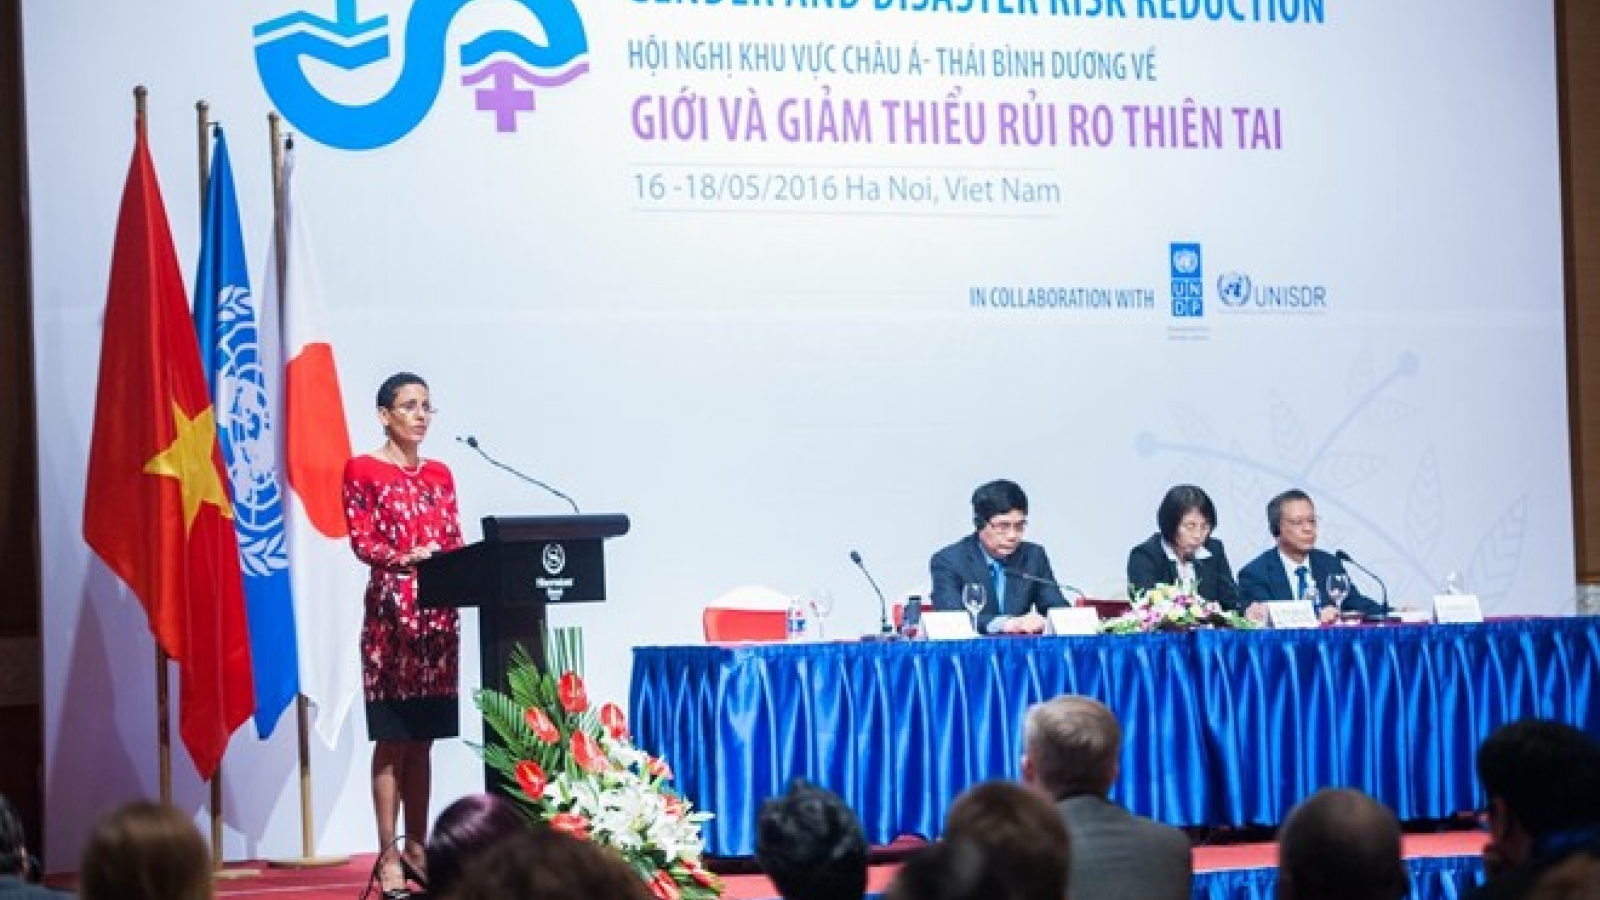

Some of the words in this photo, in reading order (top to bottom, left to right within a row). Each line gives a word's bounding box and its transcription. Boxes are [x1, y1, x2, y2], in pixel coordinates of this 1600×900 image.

[628, 34, 668, 76] HỘI
[675, 40, 732, 78] NGHỊ
[739, 42, 786, 72] KHU
[790, 40, 836, 81] VỰC
[842, 40, 900, 75] CHÂU
[936, 42, 985, 77] THÁI
[993, 44, 1045, 78] BÌNH
[631, 85, 709, 142] GIỚI
[719, 86, 767, 142] VÀ
[777, 85, 872, 144] GIẢM
[881, 85, 987, 145] THIỂU
[999, 89, 1057, 147] RỦI
[1069, 104, 1114, 147] RO
[1122, 97, 1222, 149] THIÊN
[1231, 107, 1282, 149] TAI
[634, 173, 665, 201] 16
[846, 176, 880, 202] Ha
[889, 176, 938, 205] Noi,
[944, 176, 994, 203] Viet
[1002, 178, 1061, 203] Nam
[970, 286, 985, 308] IN
[990, 286, 1112, 309] COLLABORATION
[1115, 288, 1155, 309] WITH
[1255, 284, 1327, 308] UNISDR
